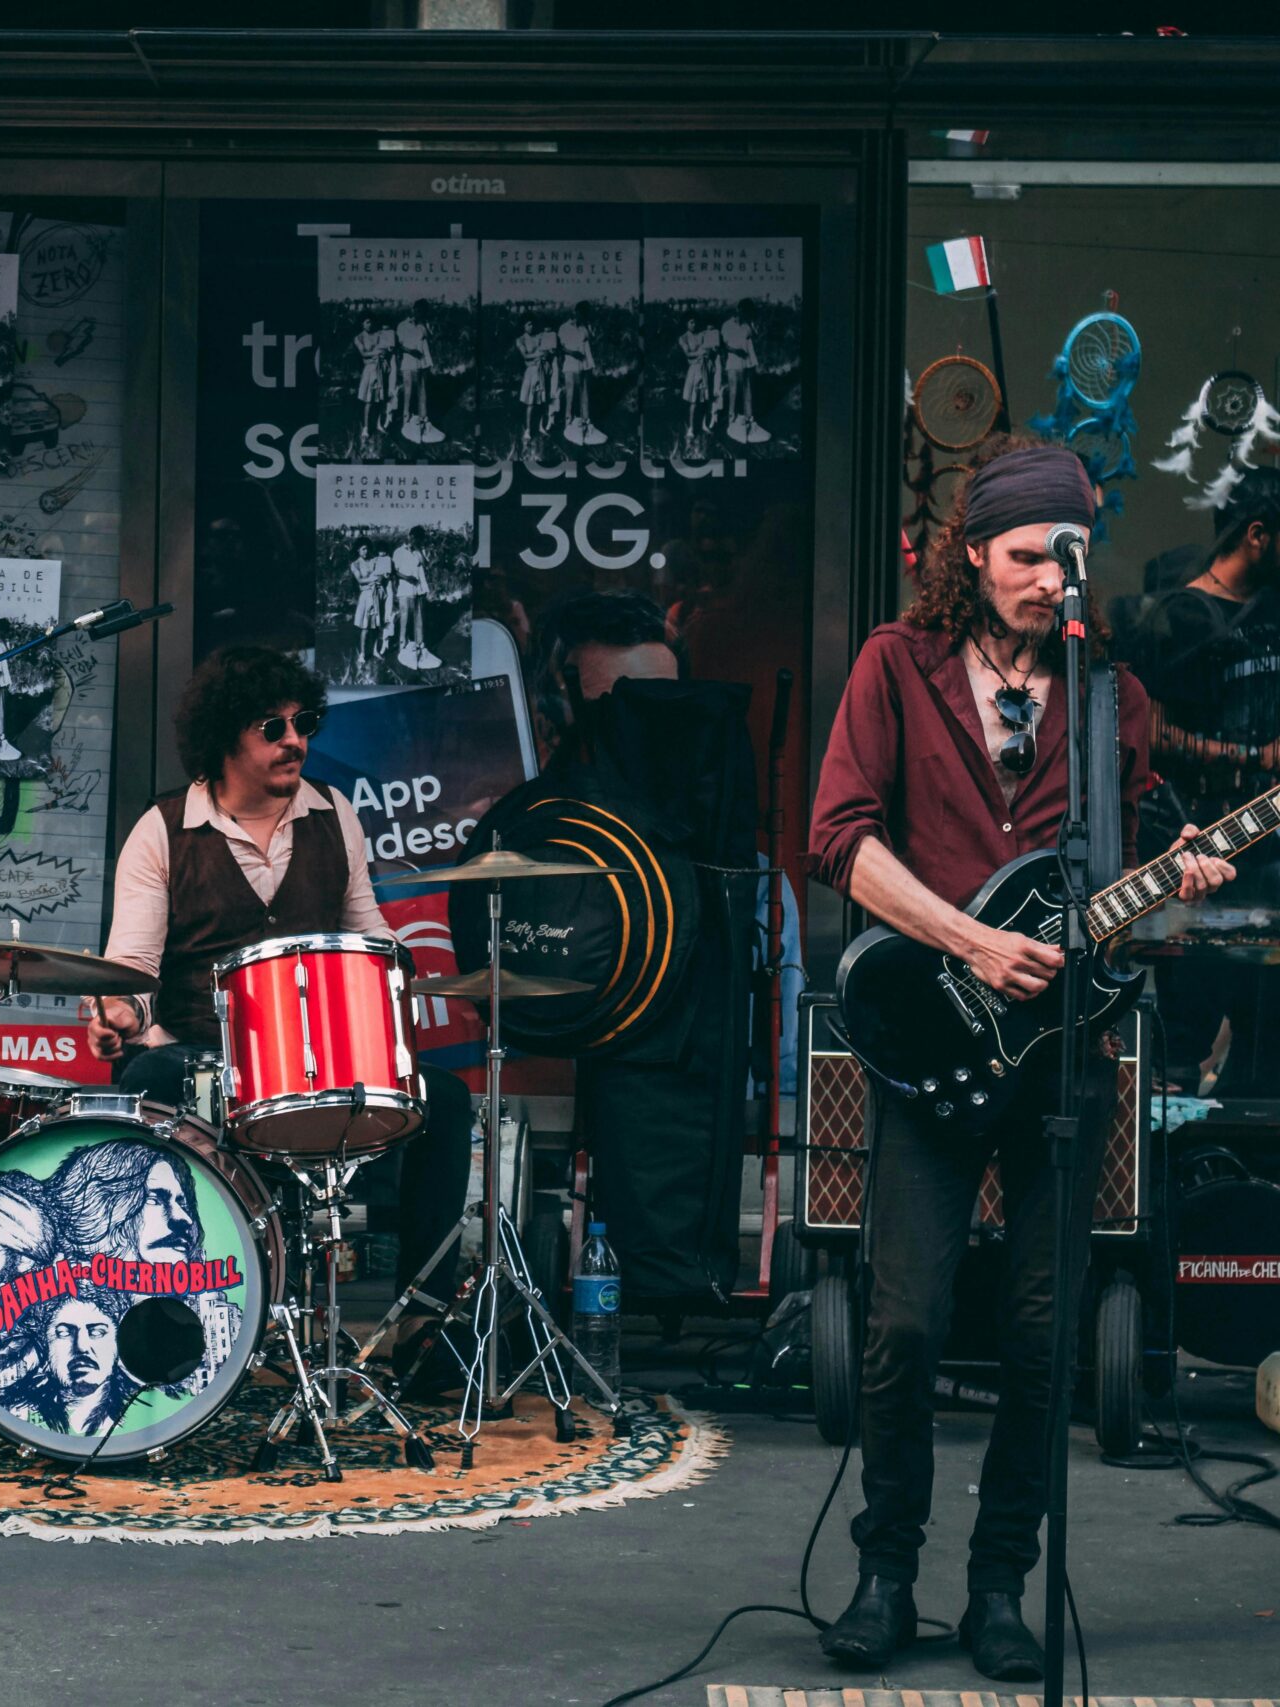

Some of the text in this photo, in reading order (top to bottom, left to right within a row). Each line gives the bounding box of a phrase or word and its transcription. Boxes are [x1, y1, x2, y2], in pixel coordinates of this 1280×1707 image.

[430, 172, 507, 195] otima
[37, 243, 77, 266] NOTA
[339, 248, 461, 260] PICANHA DE
[500, 250, 623, 262] PICANHA DE
[662, 247, 785, 259] PICANHA DE
[338, 262, 461, 273] CHERNOBILL
[499, 263, 622, 275] CHERNOBILL
[662, 261, 785, 273] CHERNOBILL
[31, 262, 90, 298] ZERO
[242, 320, 320, 389] tr
[335, 475, 457, 487] PICANHA DE
[334, 489, 457, 500] CHERNOBILL
[519, 491, 667, 571] 3G.
[23, 570, 44, 581] DE
[351, 773, 442, 819] App
[505, 920, 574, 945] Safe & Sound
[71, 1264, 92, 1279] de
[91, 1252, 244, 1295] CHERNOBILL
[1178, 1260, 1239, 1279] PICANHA
[1252, 1259, 1280, 1279] CHE
